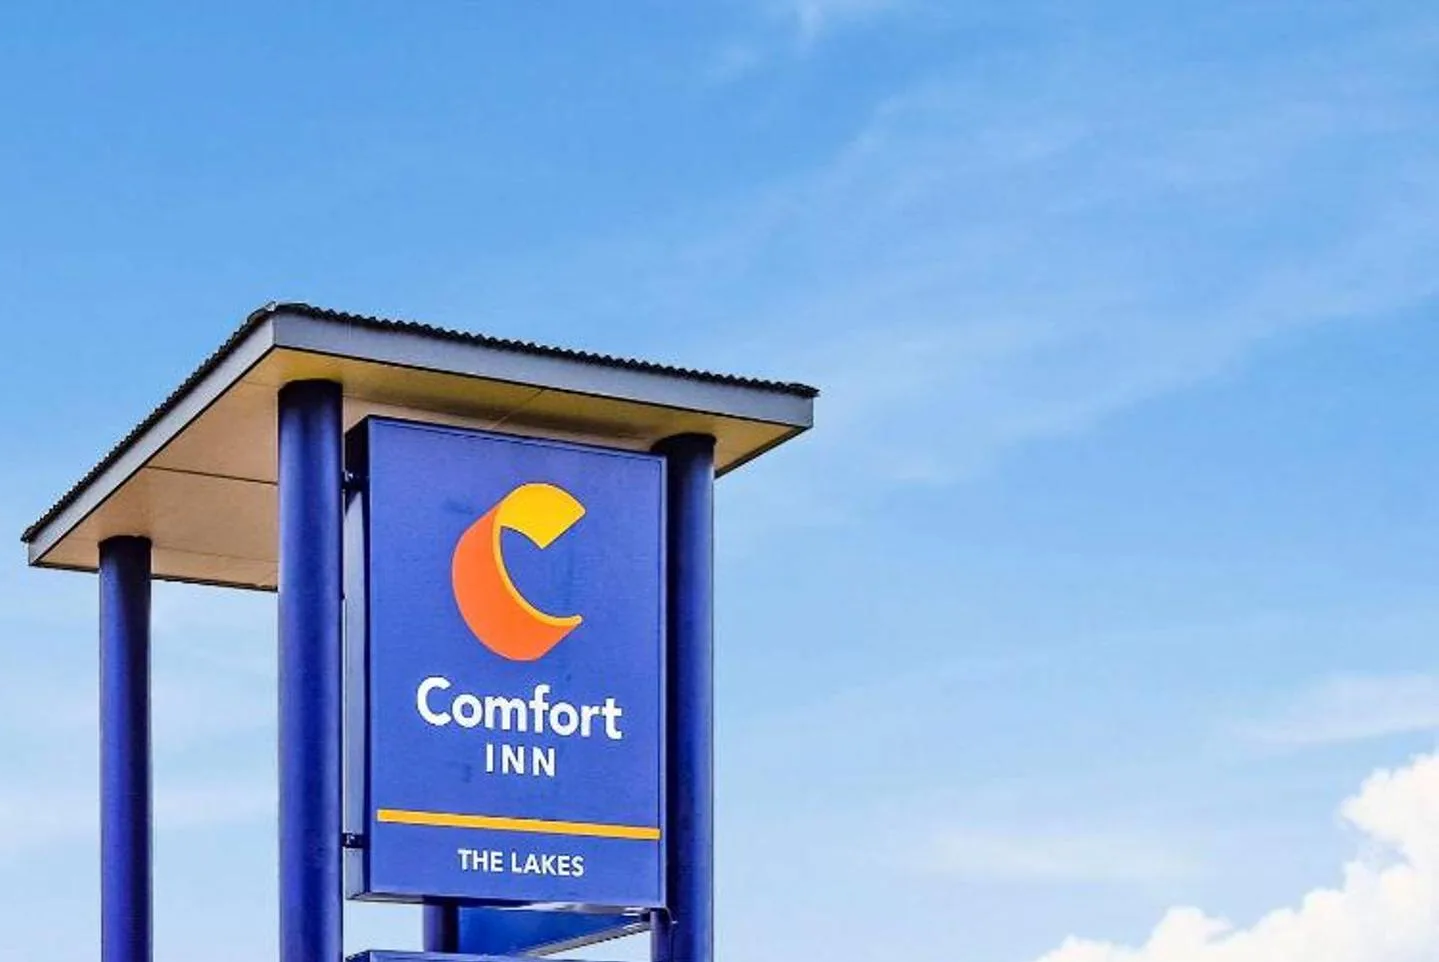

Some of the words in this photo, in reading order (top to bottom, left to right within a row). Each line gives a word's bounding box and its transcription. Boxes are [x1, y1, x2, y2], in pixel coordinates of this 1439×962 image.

[416, 675, 623, 739] Comfort
[486, 743, 556, 776] INN
[457, 848, 504, 872] THE
[511, 851, 584, 877] LAKES
